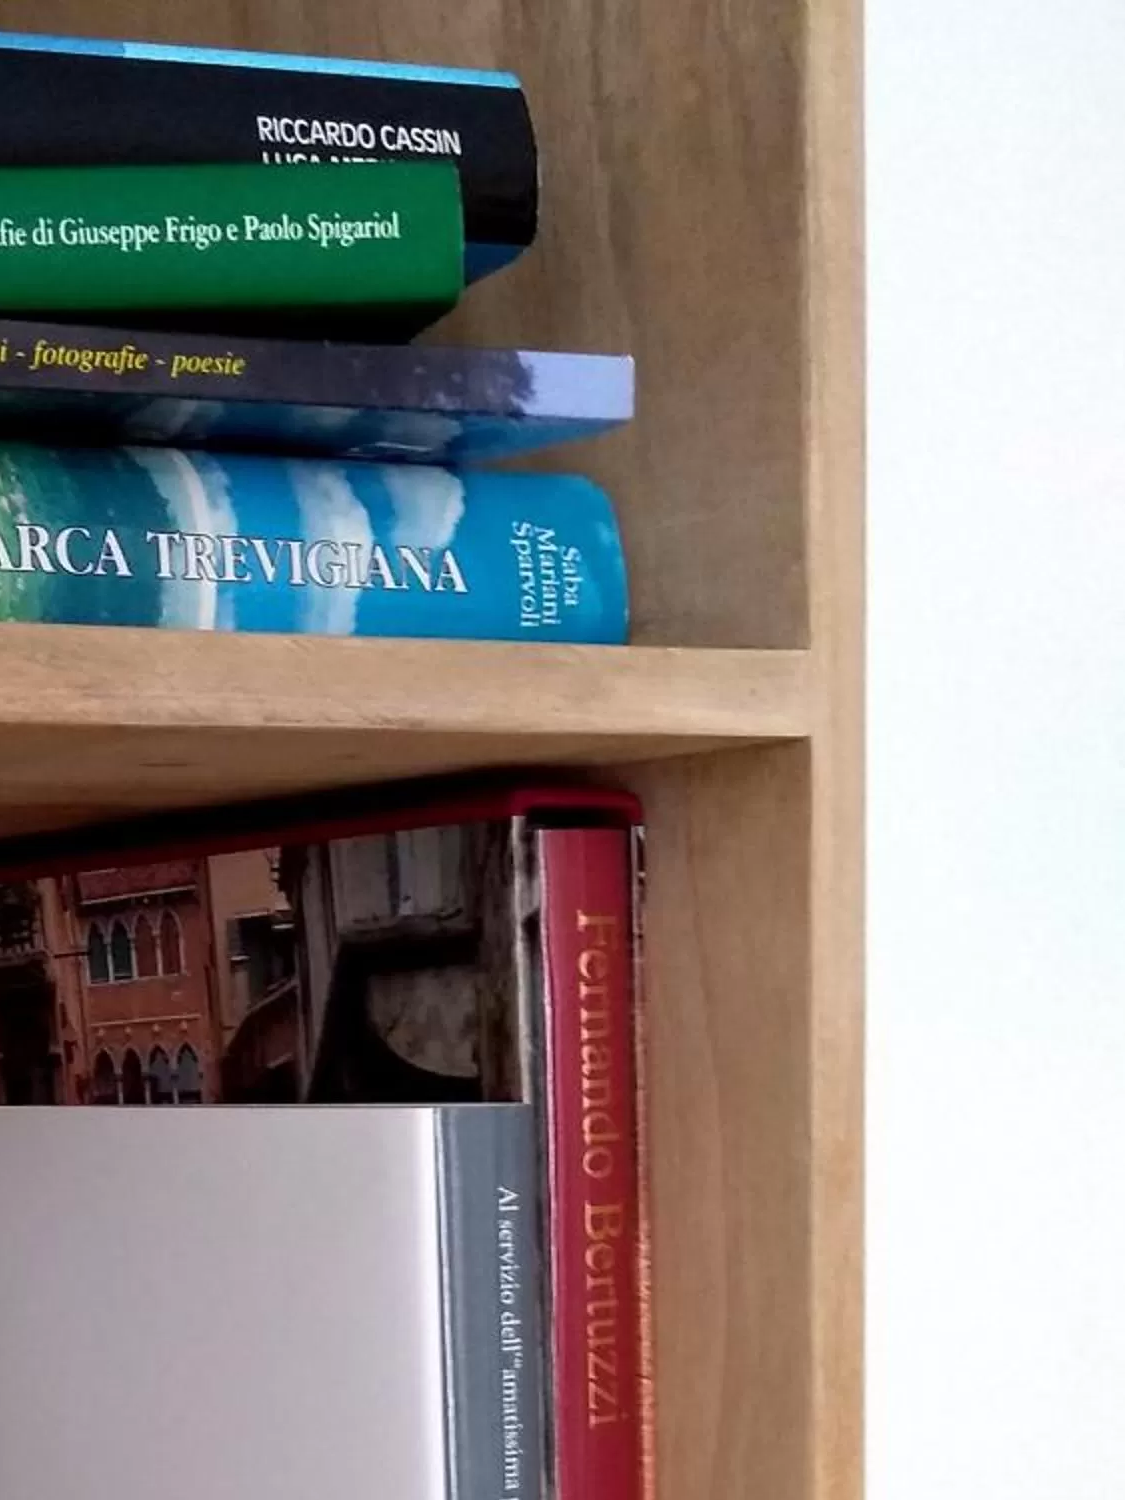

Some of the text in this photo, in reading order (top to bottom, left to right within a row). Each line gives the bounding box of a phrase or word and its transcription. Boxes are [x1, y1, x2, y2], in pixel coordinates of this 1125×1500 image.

[256, 116, 462, 155] RICCARDO CASSIN
[32, 217, 55, 246] di
[59, 218, 160, 252] Giuseppe
[164, 215, 222, 251] Frigo
[226, 223, 239, 242] e
[243, 213, 303, 242] Paolo
[307, 211, 401, 248] Spigariol
[29, 339, 148, 374] fotografie
[170, 351, 246, 378] poesie
[146, 530, 469, 594] TREVIGIANA
[509, 520, 541, 627] Sparvoli
[534, 526, 561, 625] Mariani
[559, 545, 583, 606] Saba
[497, 1186, 520, 1211] Al
[576, 909, 628, 1429] Fernando Bertuzzi
[498, 1219, 520, 1304] servizio
